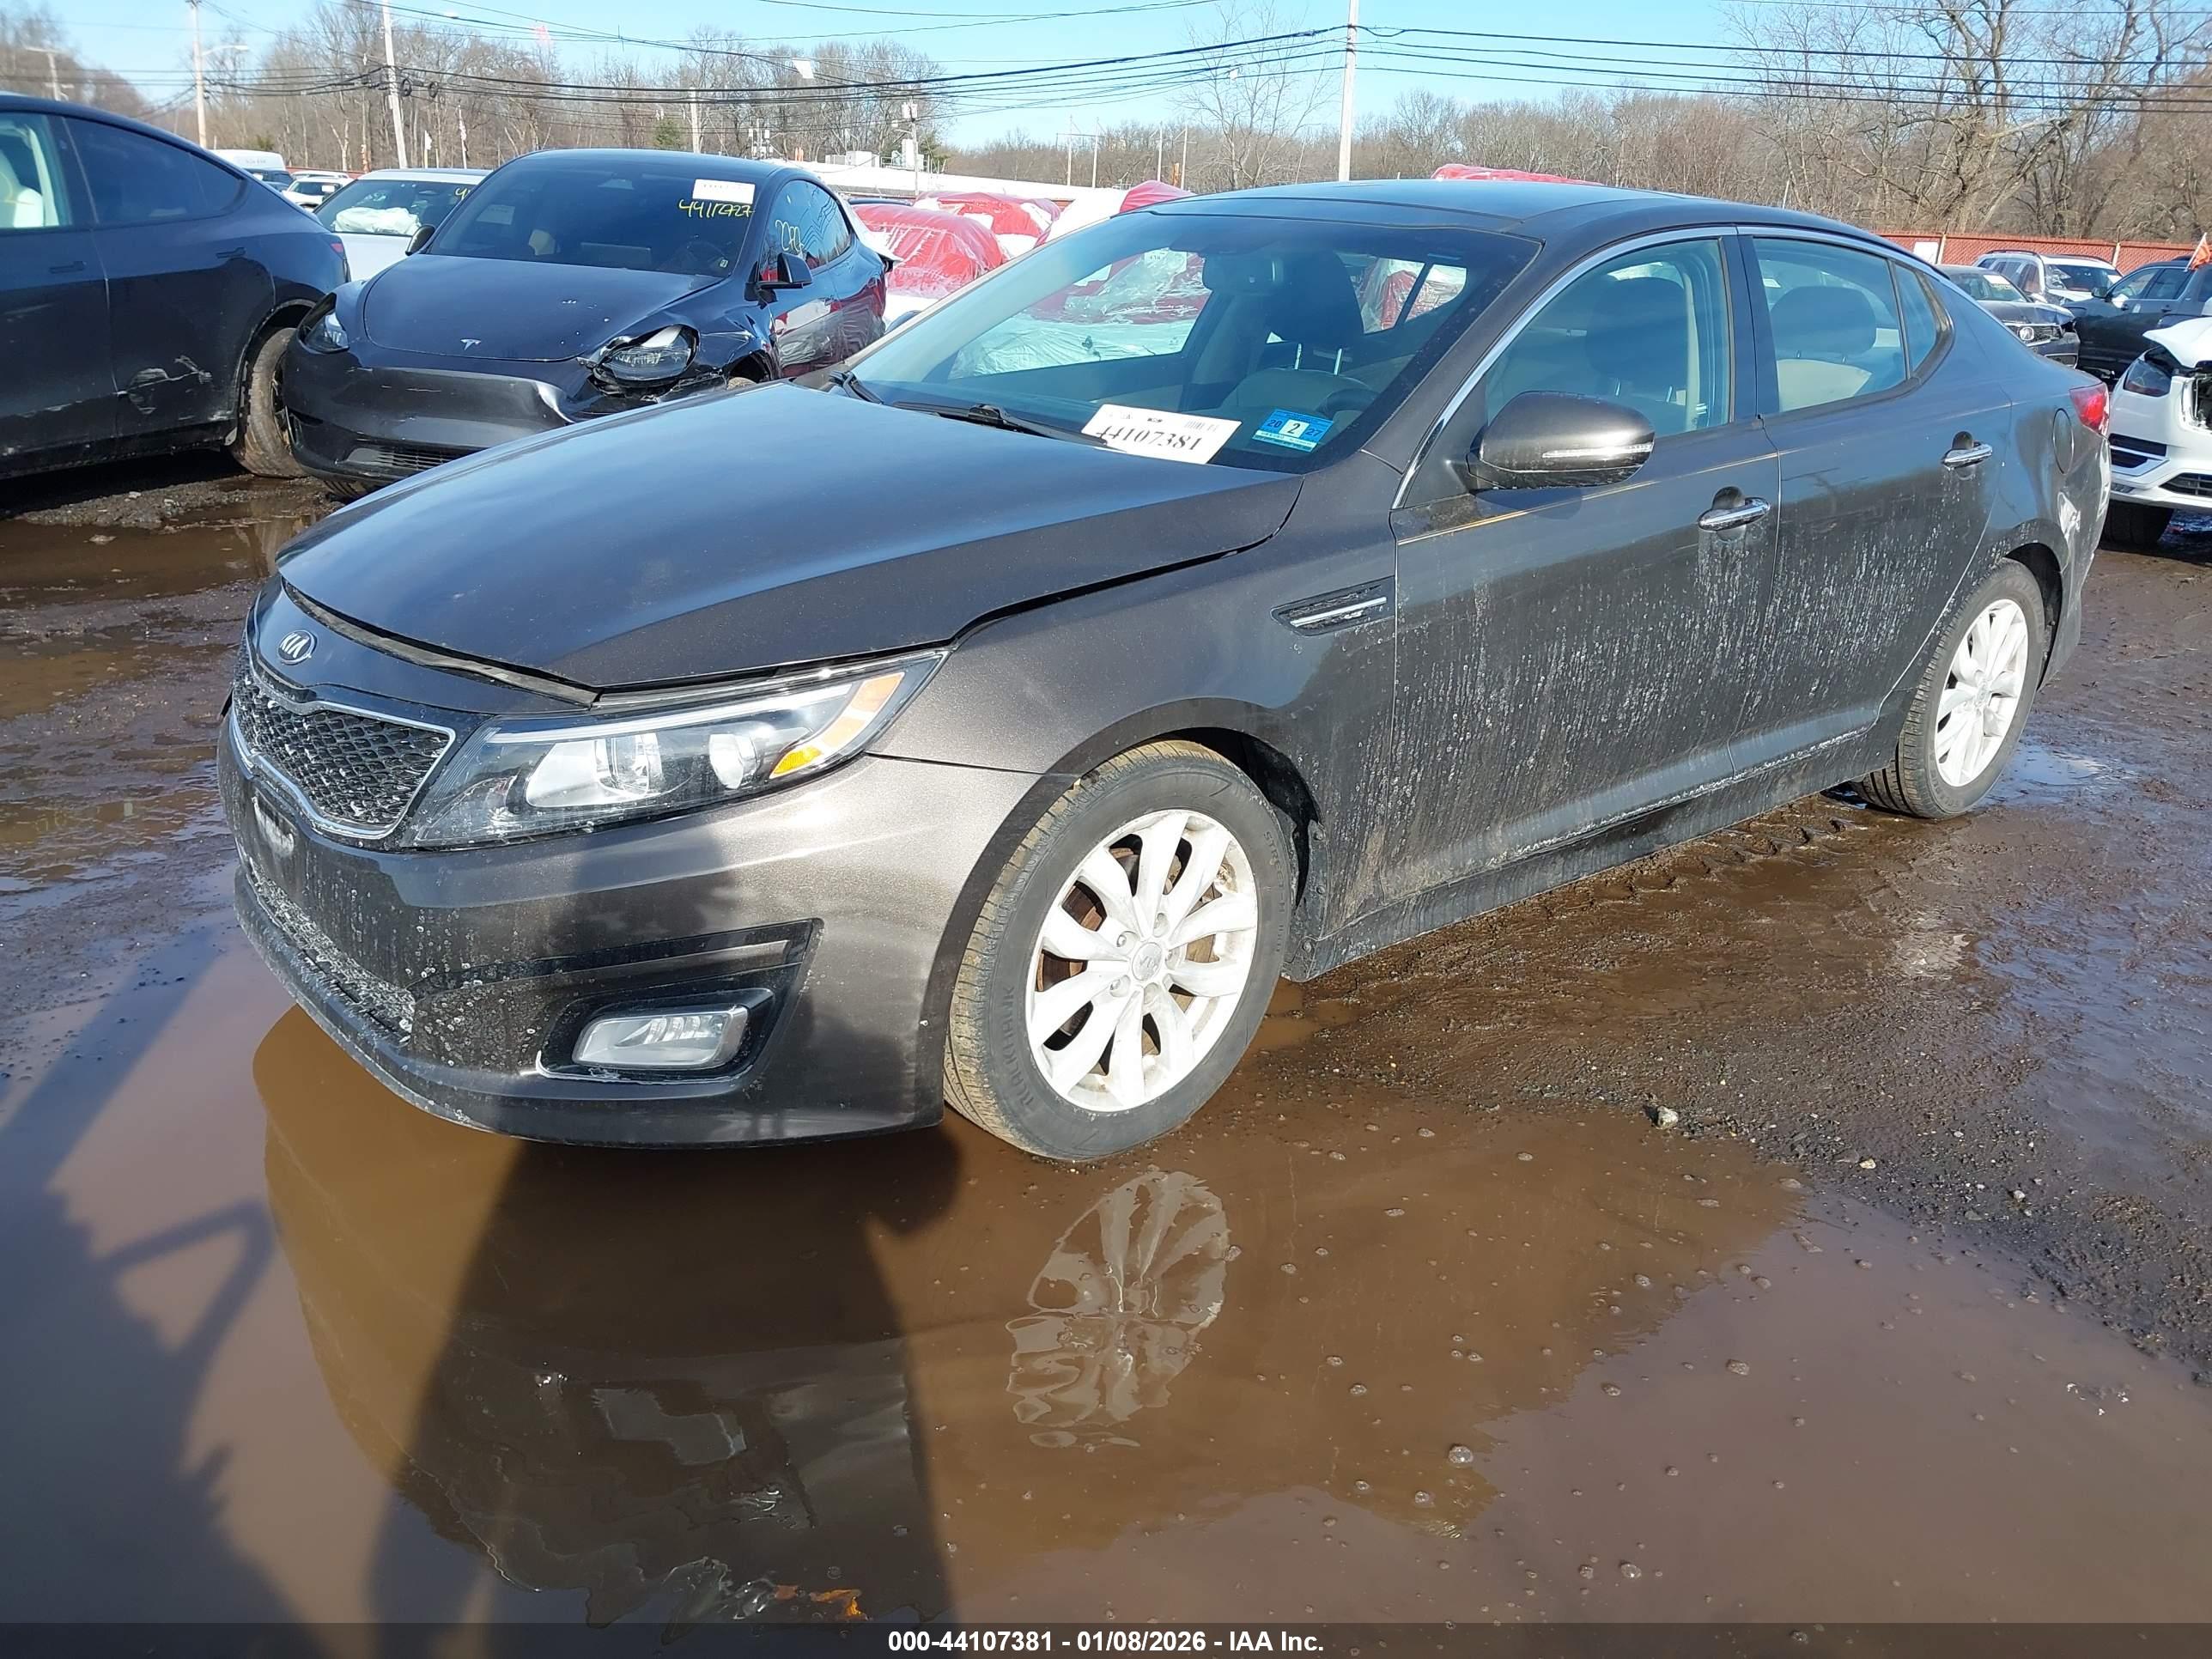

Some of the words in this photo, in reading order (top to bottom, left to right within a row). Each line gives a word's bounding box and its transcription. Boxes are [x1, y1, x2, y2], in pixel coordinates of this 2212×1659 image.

[1096, 425, 1203, 451] 44107381
[1267, 419, 1283, 428] 20
[1287, 422, 1301, 434] 2
[1305, 428, 1323, 437] 27
[279, 632, 310, 659] KIA
